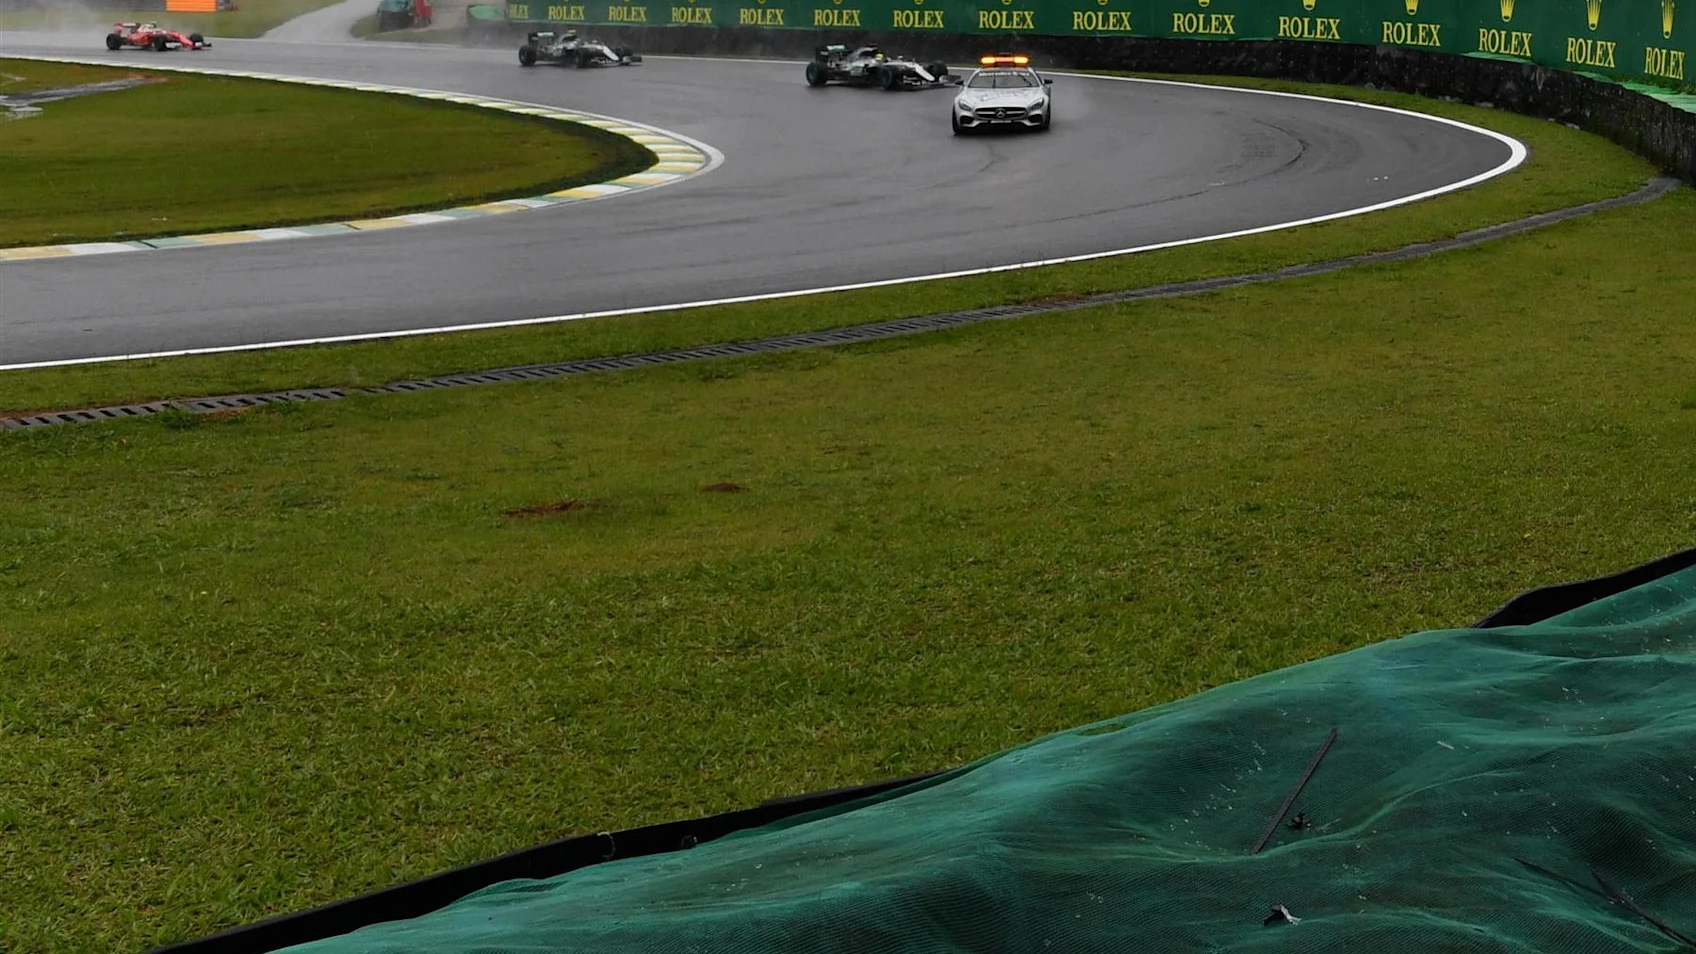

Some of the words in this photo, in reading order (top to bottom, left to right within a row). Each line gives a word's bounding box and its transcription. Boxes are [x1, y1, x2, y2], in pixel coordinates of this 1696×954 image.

[548, 4, 585, 22] ROLEX
[607, 4, 647, 23] ROLEX
[671, 6, 712, 24] ROLEX
[739, 7, 784, 27] ROLEX
[813, 8, 860, 28] ROLEX
[892, 9, 945, 30] ROLEX
[978, 10, 1034, 29] ROLEX
[1072, 10, 1131, 31] ROLEX
[1172, 12, 1234, 35] ROLEX
[1278, 16, 1340, 41] ROLEX
[1382, 21, 1441, 47] ROLEX
[1478, 27, 1532, 58] ROLEX
[1566, 37, 1616, 69] ROLEX
[1645, 47, 1685, 80] ROLEX
